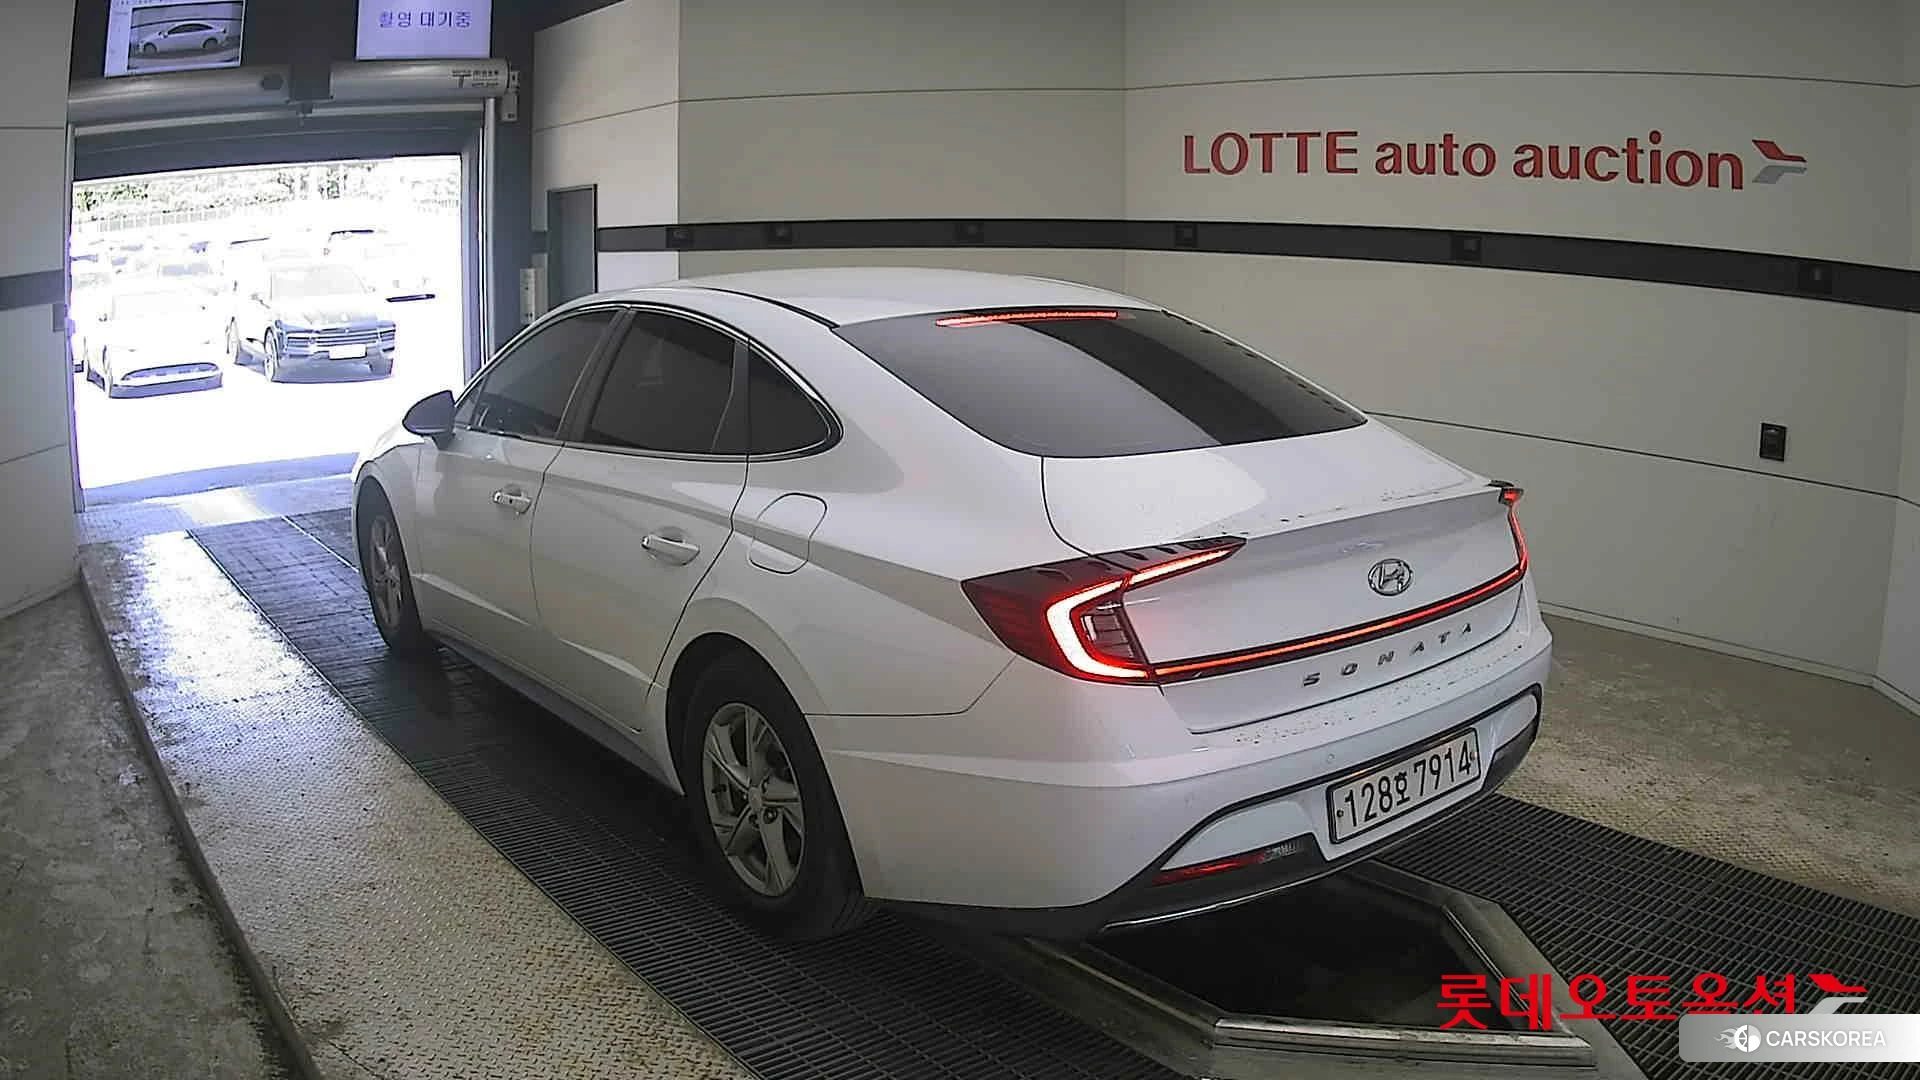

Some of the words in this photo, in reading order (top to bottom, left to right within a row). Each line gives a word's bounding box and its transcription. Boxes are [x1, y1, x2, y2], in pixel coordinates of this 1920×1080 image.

[420, 11, 471, 28] 대기중
[1184, 131, 1358, 174] LOTTE
[1376, 133, 1496, 177] auto
[1512, 130, 1744, 190] auction
[1302, 623, 1473, 687] SONATA
[1344, 771, 1410, 827] 128호
[1413, 740, 1472, 797] 7914
